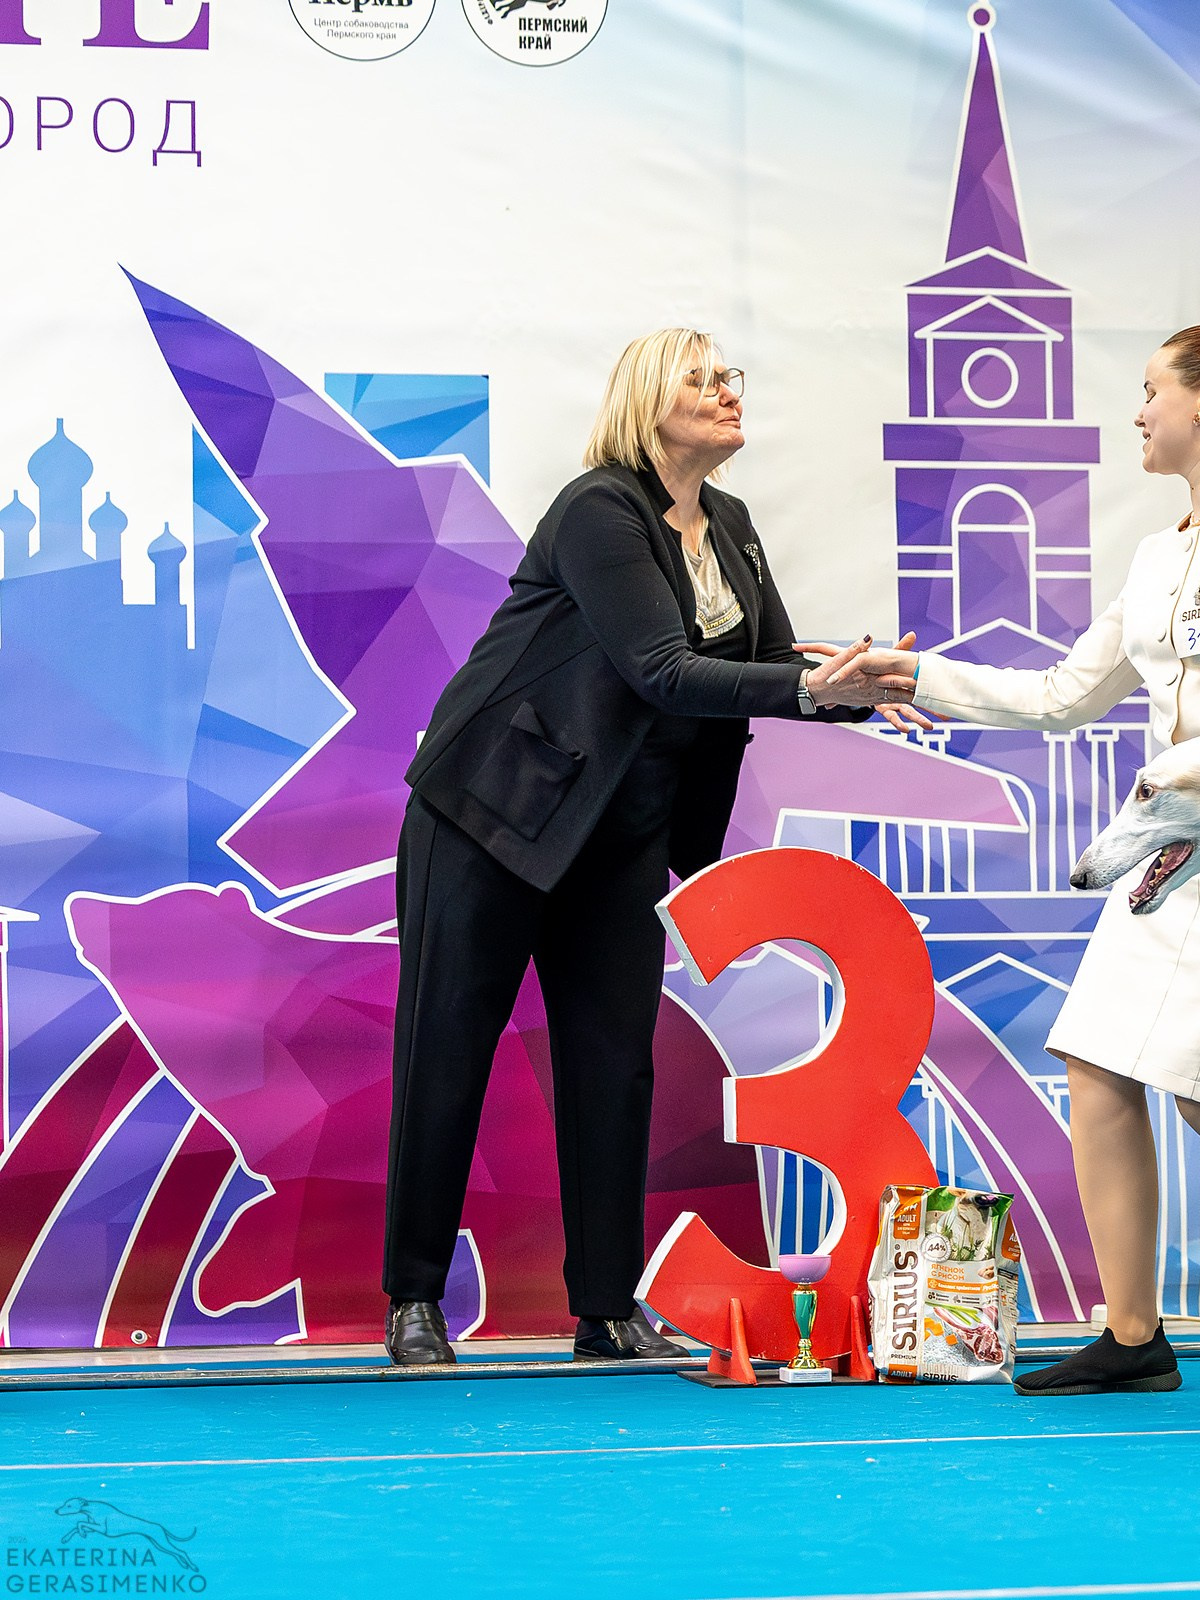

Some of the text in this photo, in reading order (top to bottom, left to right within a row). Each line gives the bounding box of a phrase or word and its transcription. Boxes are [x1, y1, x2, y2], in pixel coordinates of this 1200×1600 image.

[313, 18, 409, 29] Центр собаководства
[518, 17, 588, 33] ПЕРМСКИЙ
[326, 29, 397, 40] Пермского края
[518, 34, 552, 50] КРАЙ
[634, 846, 941, 1362] 3
[897, 1214, 917, 1223] ADULT
[922, 1372, 958, 1383] SIRIUS
